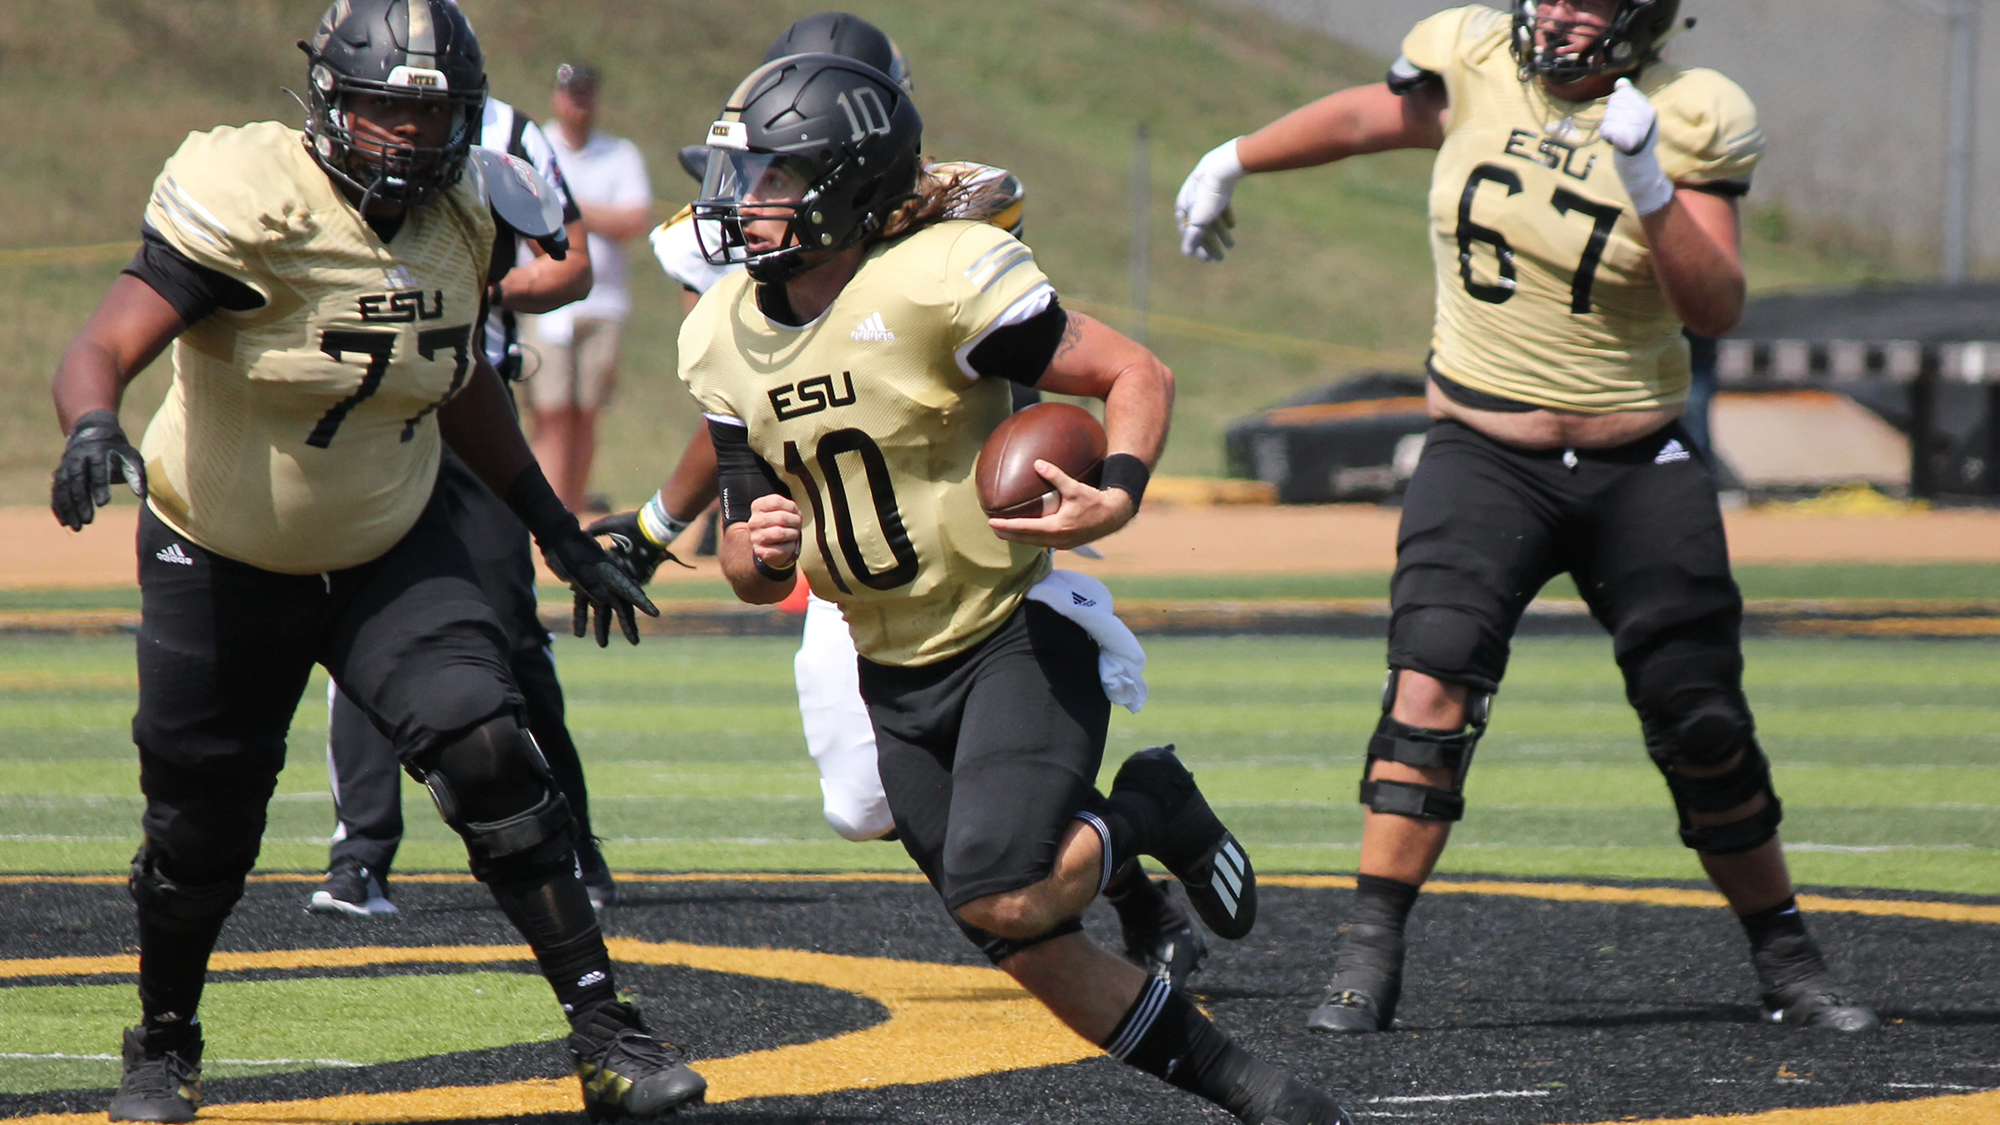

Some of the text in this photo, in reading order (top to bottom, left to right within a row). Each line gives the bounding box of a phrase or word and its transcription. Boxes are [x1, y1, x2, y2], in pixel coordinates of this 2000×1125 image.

[836, 86, 892, 142] 10
[1504, 127, 1597, 181] ESU
[1456, 163, 1623, 315] 67
[359, 289, 443, 323] ESU
[304, 324, 472, 449] 77
[767, 371, 857, 422] ESU
[783, 427, 919, 596] 10
